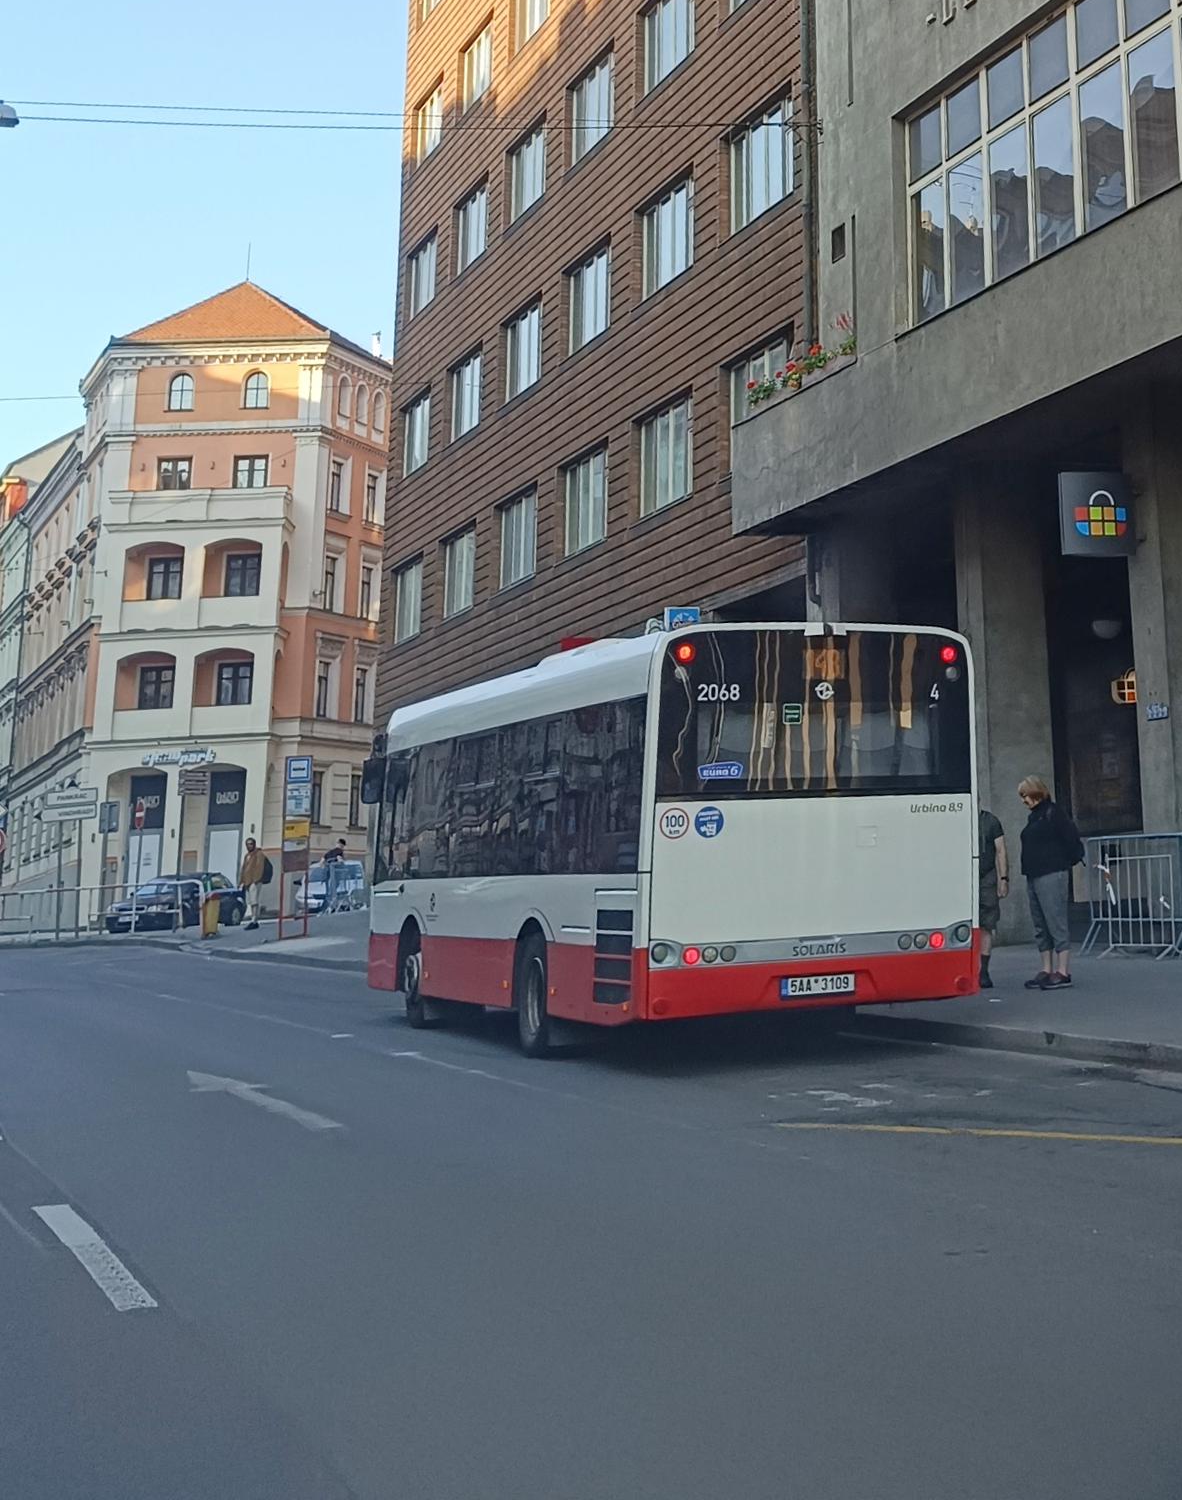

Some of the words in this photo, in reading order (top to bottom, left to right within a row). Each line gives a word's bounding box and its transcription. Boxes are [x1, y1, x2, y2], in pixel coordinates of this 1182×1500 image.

[697, 683, 740, 701] 2068
[930, 683, 939, 700] 4
[665, 814, 685, 828] 100
[668, 828, 680, 836] km
[792, 942, 847, 957] SOLARIS
[790, 978, 812, 993] 5AA
[821, 976, 849, 991] 3109
